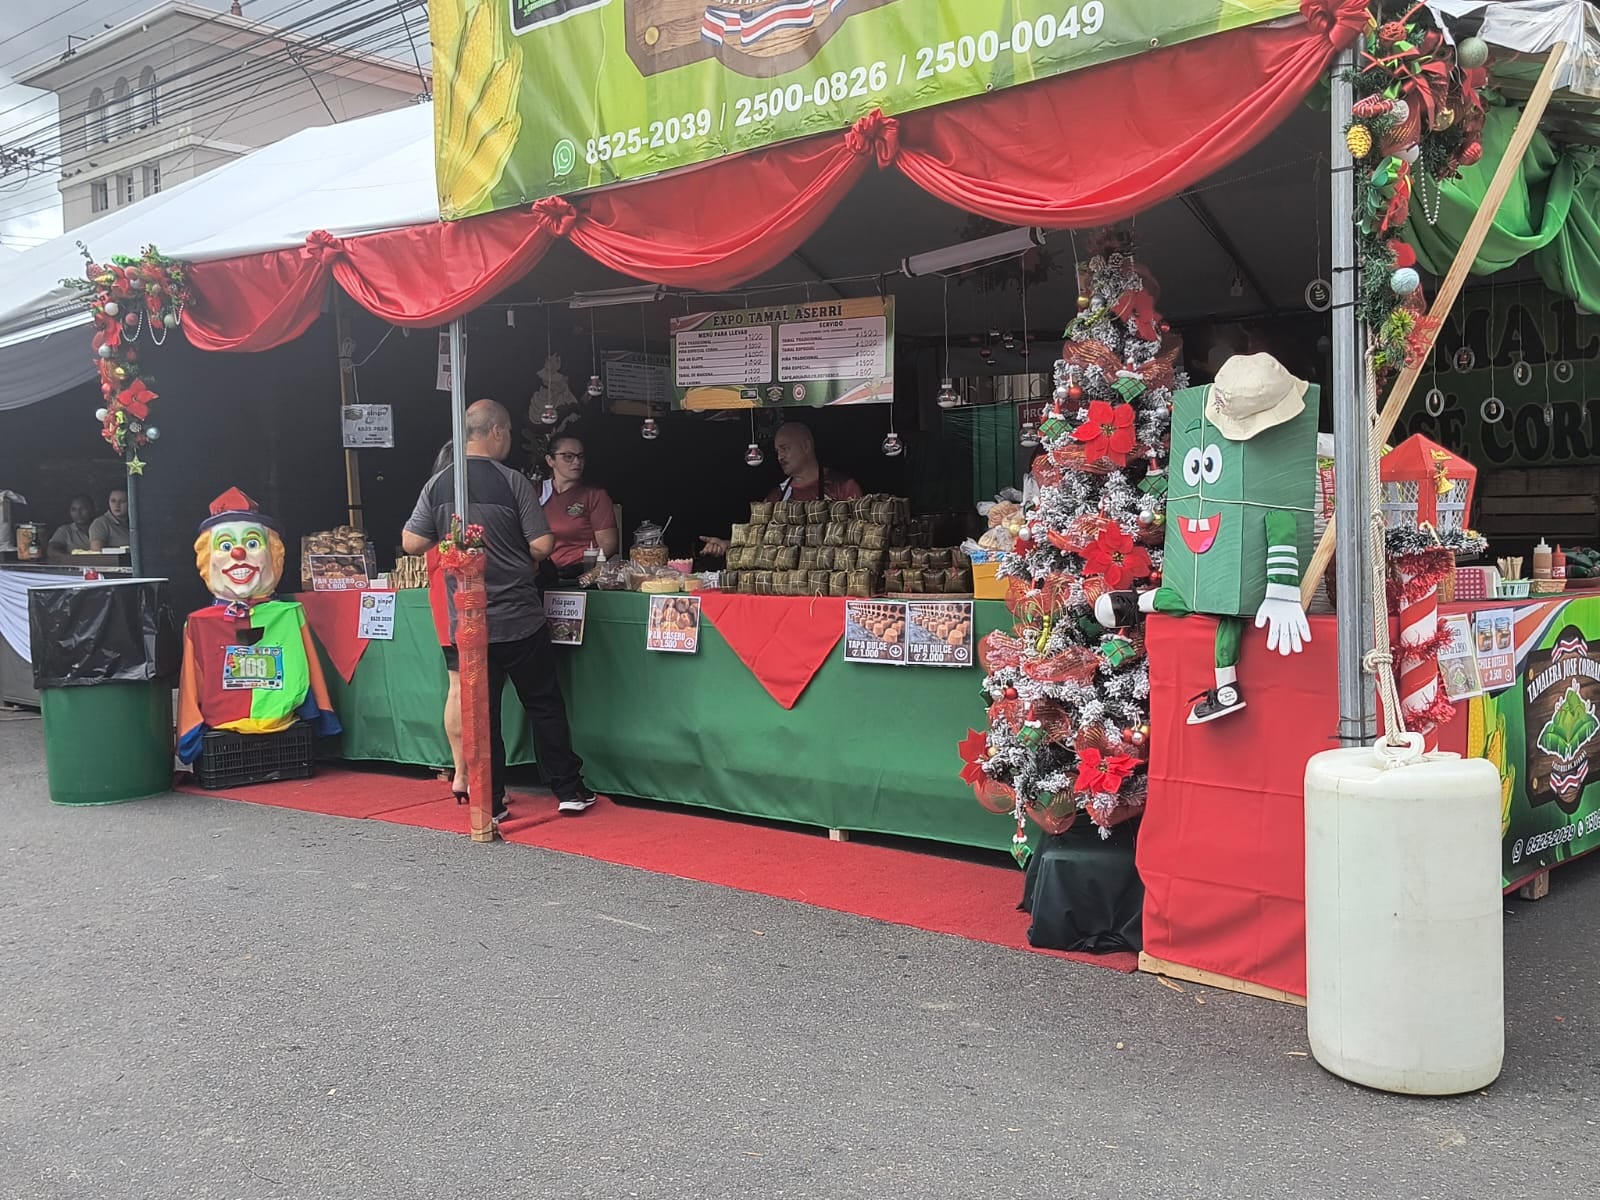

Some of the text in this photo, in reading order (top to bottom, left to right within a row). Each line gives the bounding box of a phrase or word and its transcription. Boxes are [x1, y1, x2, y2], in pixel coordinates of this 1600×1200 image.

[584, 108, 711, 164] 8525-2039
[735, 61, 887, 126] 2500-0826
[915, 0, 1104, 80] 2500-0049
[713, 313, 743, 326] EXPO
[749, 310, 789, 323] TAMAL
[663, 631, 686, 641] CASERO
[848, 640, 888, 651] TAPA DULCE
[910, 643, 952, 654] TAPA DULCE
[1527, 662, 1562, 704] TAMALERA
[1563, 658, 1578, 680] JOSE
